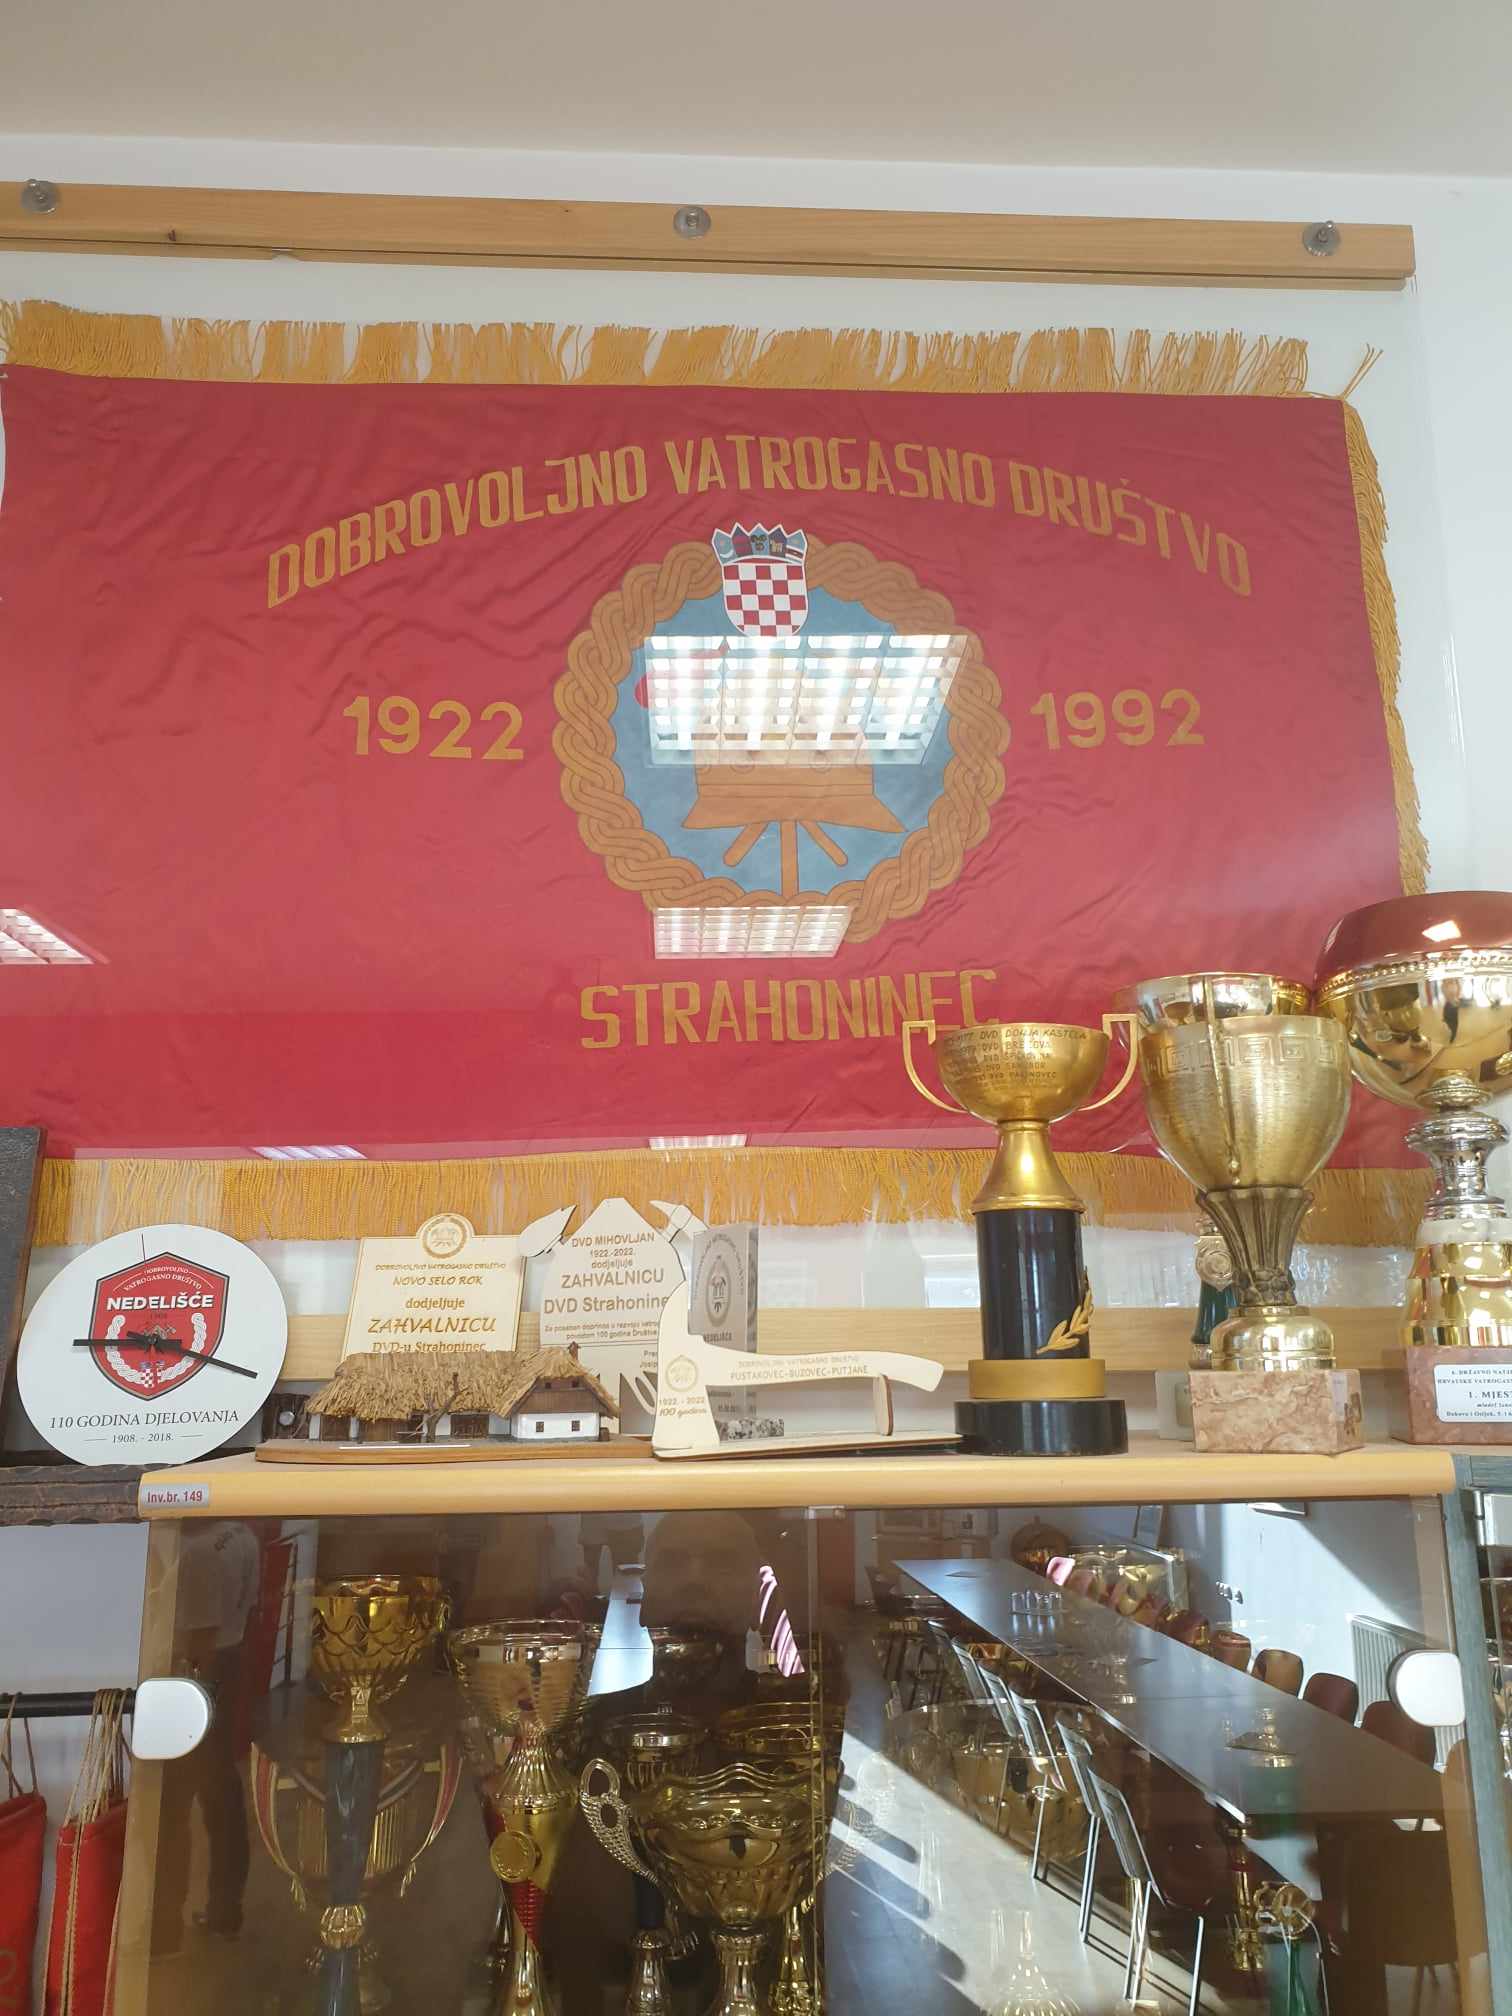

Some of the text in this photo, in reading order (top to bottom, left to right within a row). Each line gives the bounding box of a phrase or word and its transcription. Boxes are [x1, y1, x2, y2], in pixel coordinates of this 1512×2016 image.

[267, 435, 1251, 608] DOBROVOLJNO VATROGASNO DRUŠTVO
[343, 695, 524, 760] 1922
[1030, 689, 1204, 750] 1992
[580, 970, 998, 1048] STRAHONINEC
[571, 1232, 654, 1248] DVD MIHOVLJAN
[393, 1275, 483, 1286] NOVO SELO ROK
[561, 1268, 664, 1289] ZAHVALNICU
[107, 1291, 214, 1310] NEDELIŠĆE
[405, 1297, 466, 1310] dodjeljuje
[544, 1294, 669, 1314] DVD Strahonine
[368, 1317, 497, 1334] ZAHVALNICU
[50, 1410, 239, 1429] 110 GODINA DJELOVANJA
[148, 1433, 174, 1442] 2018.
[147, 1490, 203, 1503] Inv.br. 149
